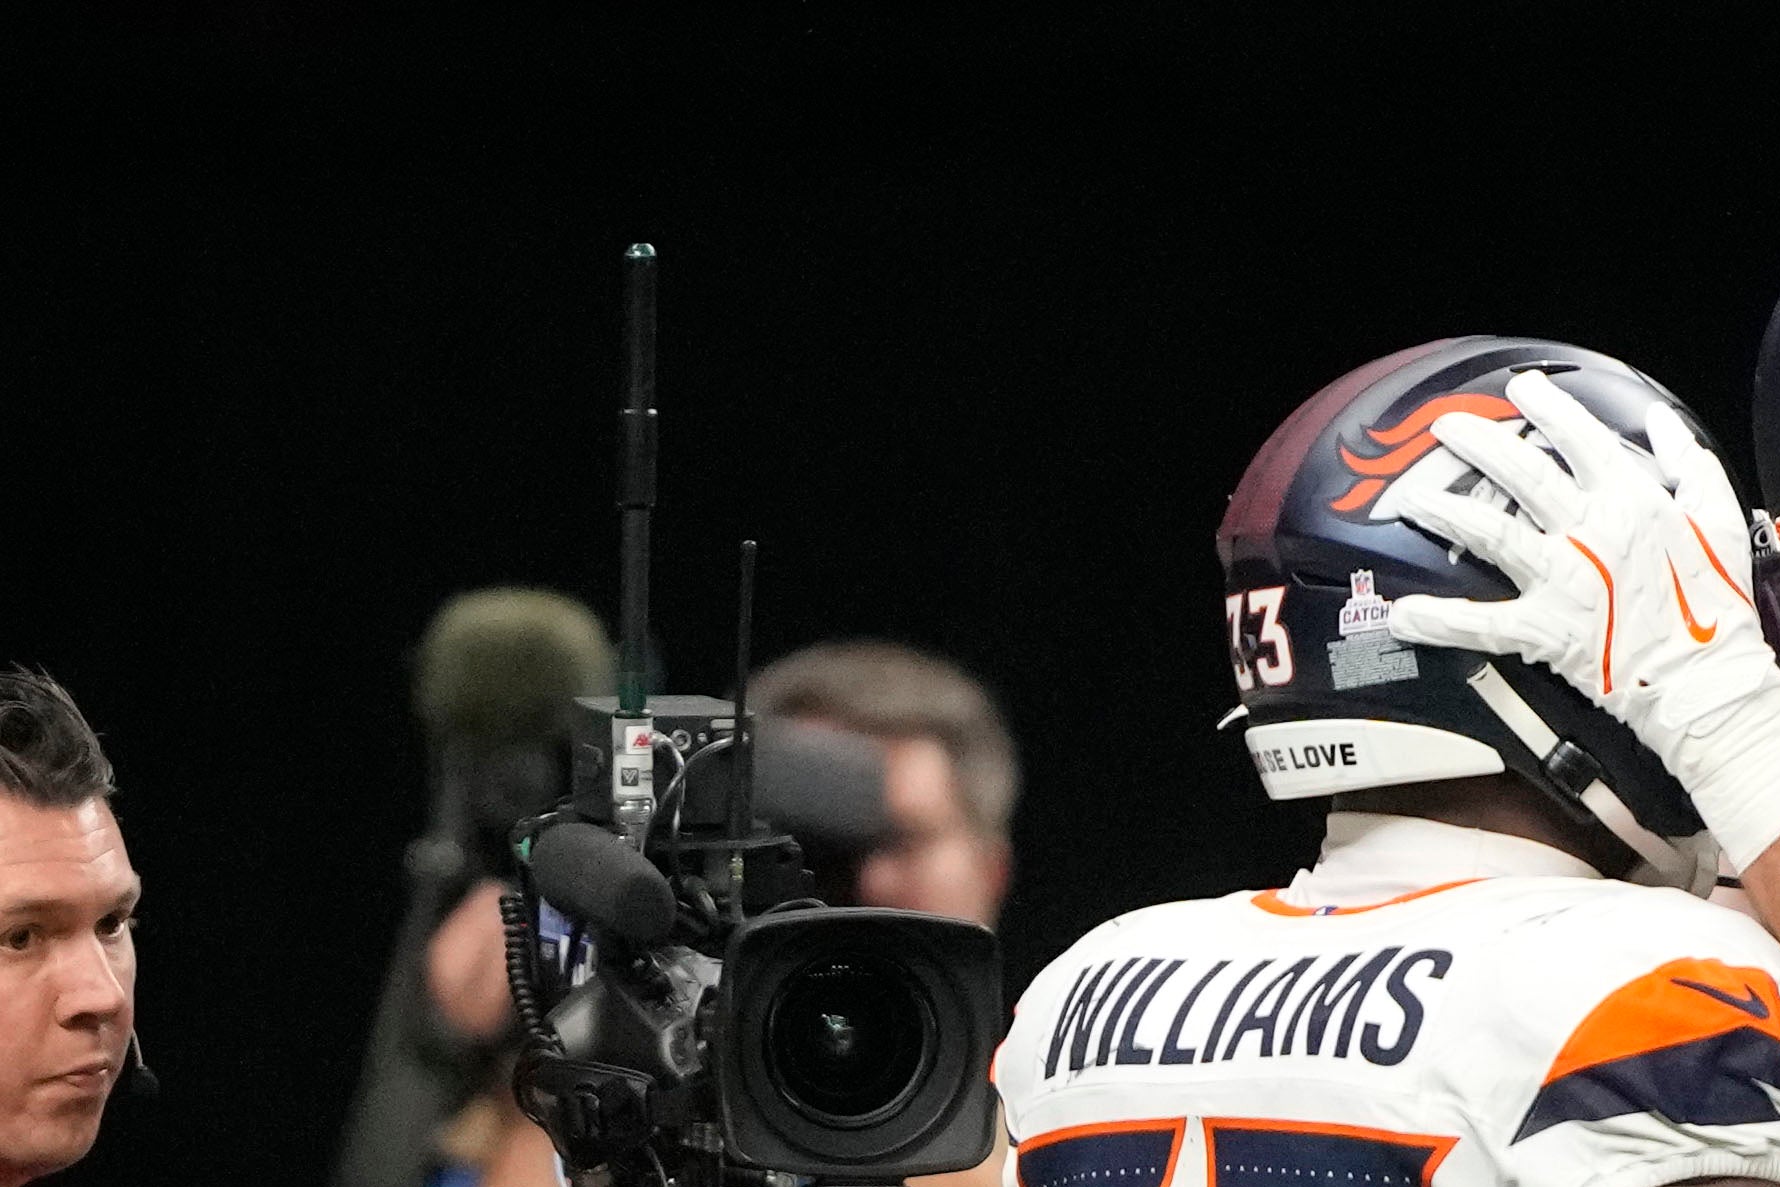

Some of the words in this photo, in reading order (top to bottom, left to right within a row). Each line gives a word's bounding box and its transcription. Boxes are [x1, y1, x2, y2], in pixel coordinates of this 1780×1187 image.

[1343, 605, 1390, 624] CATCH
[1289, 743, 1357, 770] LOVE
[1044, 945, 1453, 1080] WILLIAMS
